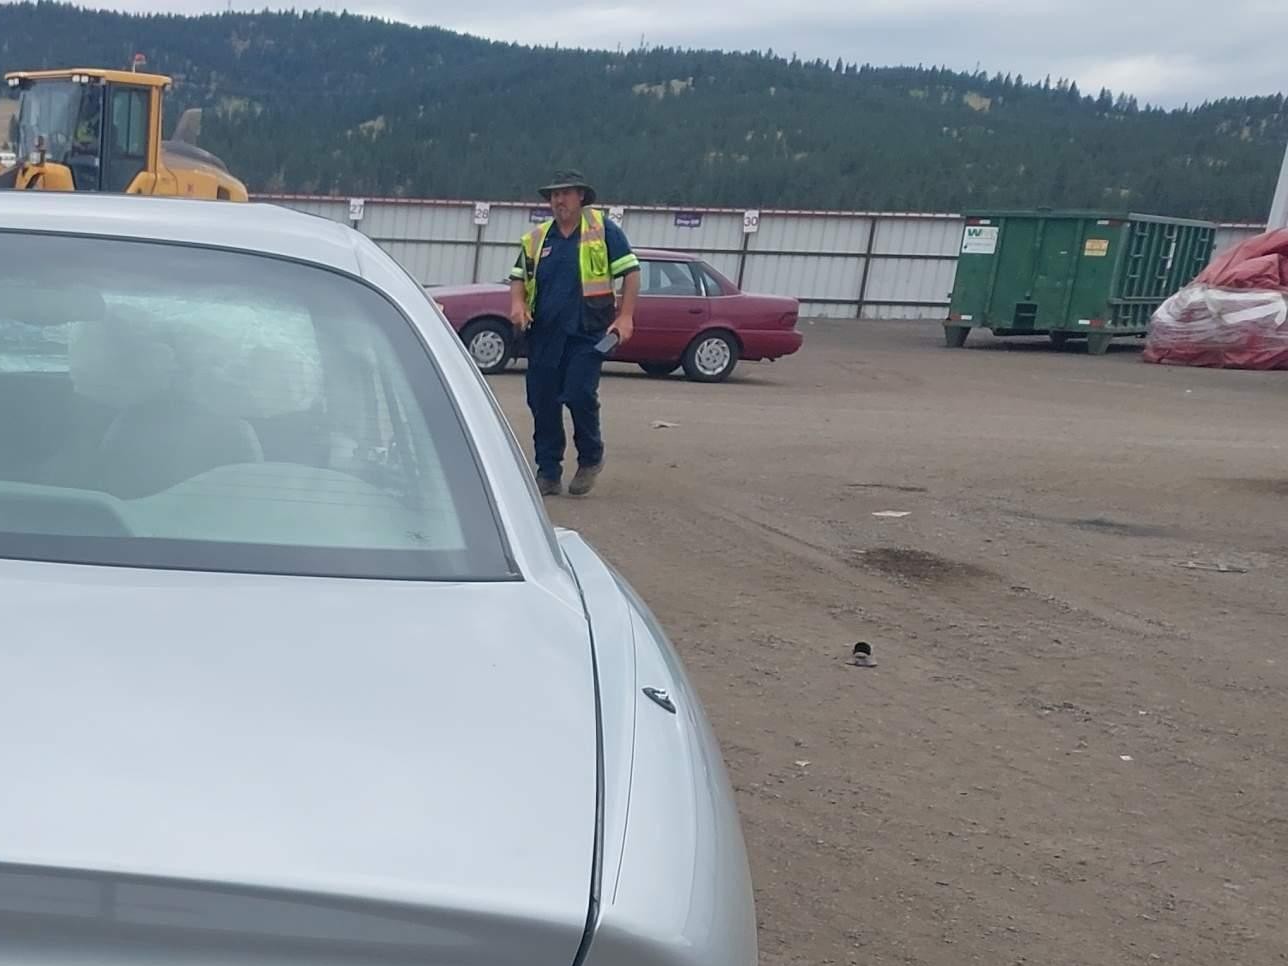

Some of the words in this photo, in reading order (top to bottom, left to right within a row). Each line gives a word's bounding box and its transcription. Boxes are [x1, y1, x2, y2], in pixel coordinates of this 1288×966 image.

[351, 204, 364, 215] 27
[475, 207, 489, 219] 28
[743, 216, 759, 227] 30
